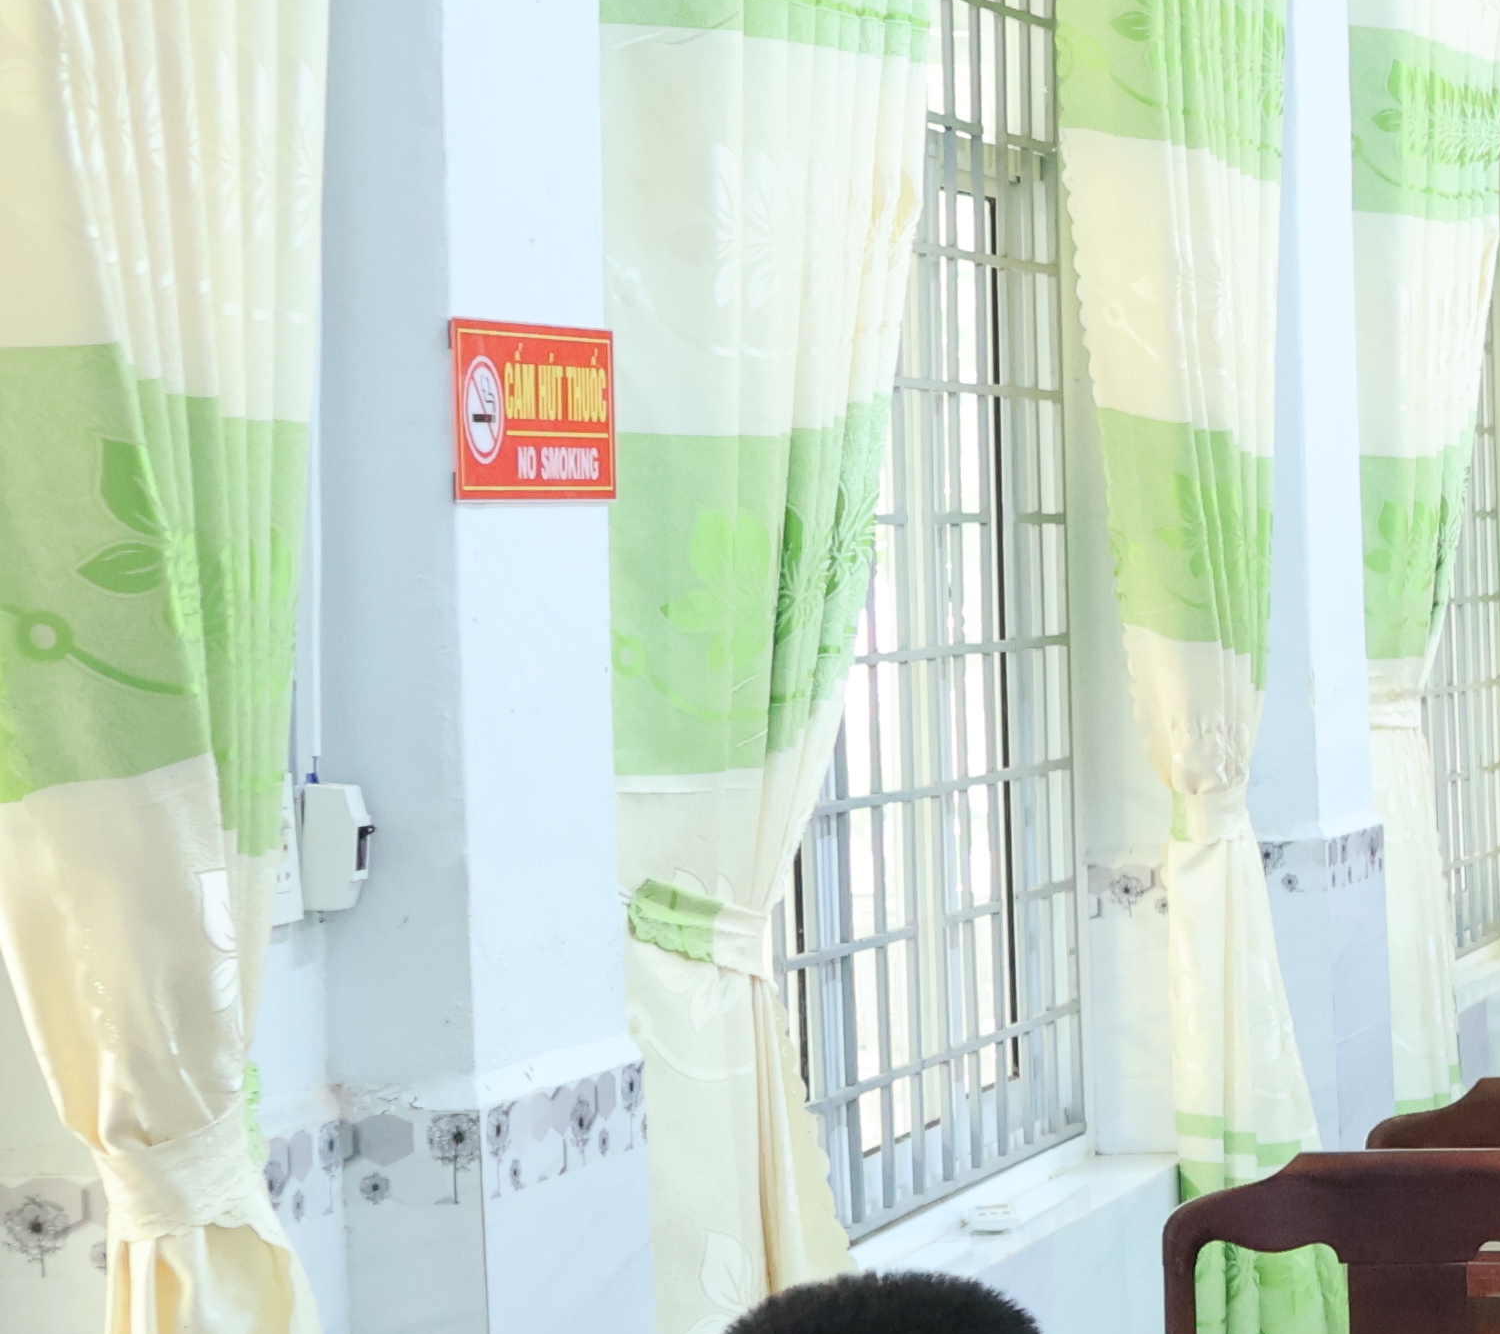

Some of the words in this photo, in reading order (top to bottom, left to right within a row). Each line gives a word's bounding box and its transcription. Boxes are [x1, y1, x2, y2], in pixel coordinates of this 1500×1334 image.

[504, 343, 536, 419] CẤM
[538, 352, 563, 421] HÚT
[565, 348, 608, 422] THUỐC
[517, 446, 537, 479] NO
[541, 446, 599, 480] SMOKING
